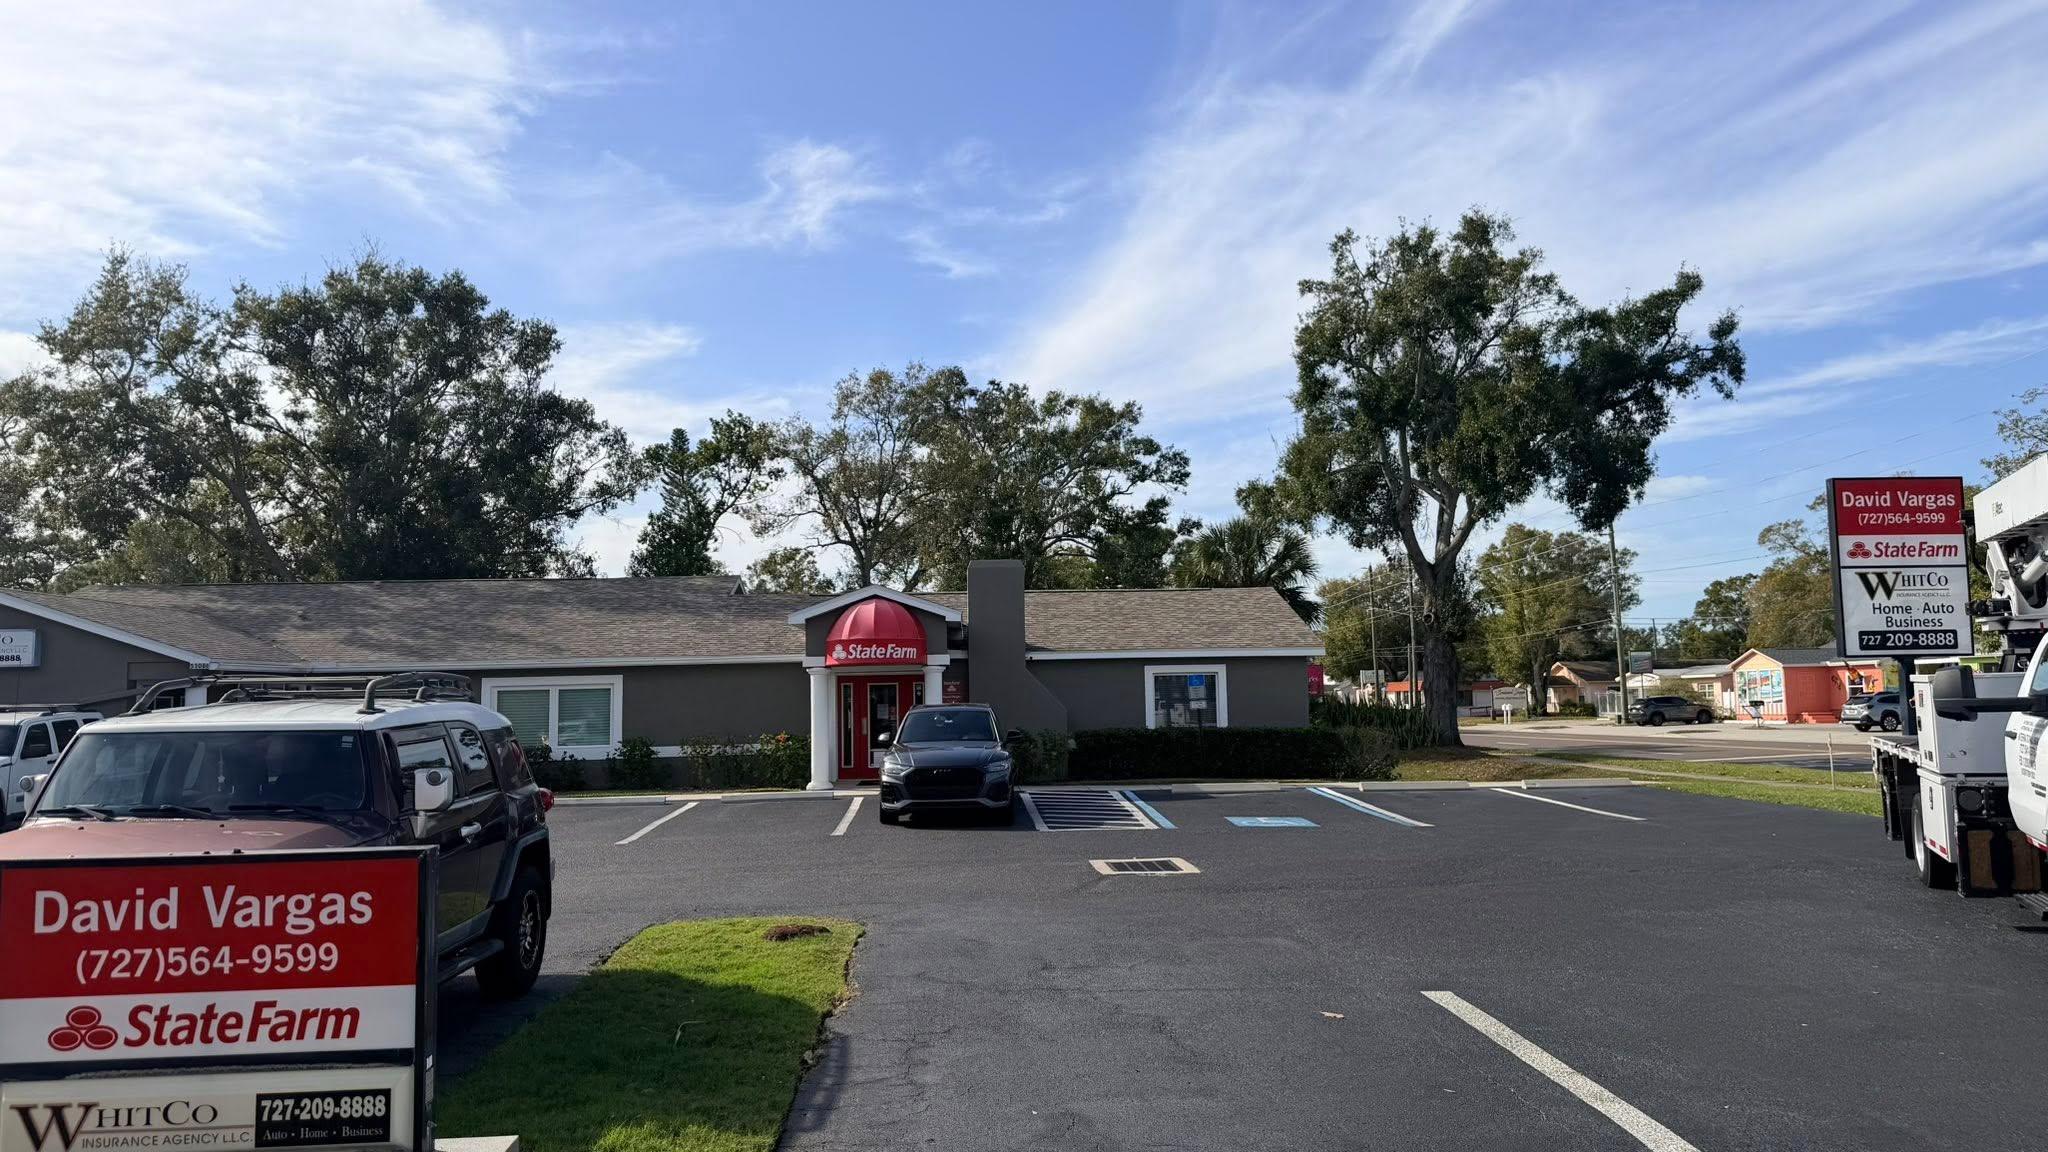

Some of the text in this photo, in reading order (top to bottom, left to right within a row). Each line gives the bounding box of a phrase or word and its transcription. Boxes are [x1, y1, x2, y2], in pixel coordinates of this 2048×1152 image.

[1841, 491, 1956, 510] David Vargas
[1858, 512, 1946, 526] (727)564-9599
[1872, 602, 1955, 615] Home Auto
[1885, 616, 1944, 628] Business
[1861, 632, 1955, 647] 727 209-8888
[33, 884, 373, 935] David Vargas
[76, 942, 339, 985] (727)564-9599
[260, 1095, 386, 1122] 727-209-8888
[82, 1135, 158, 1149] INSURANCE
[163, 1131, 219, 1145] AGENCY
[263, 1125, 383, 1140] Auto Home Business
